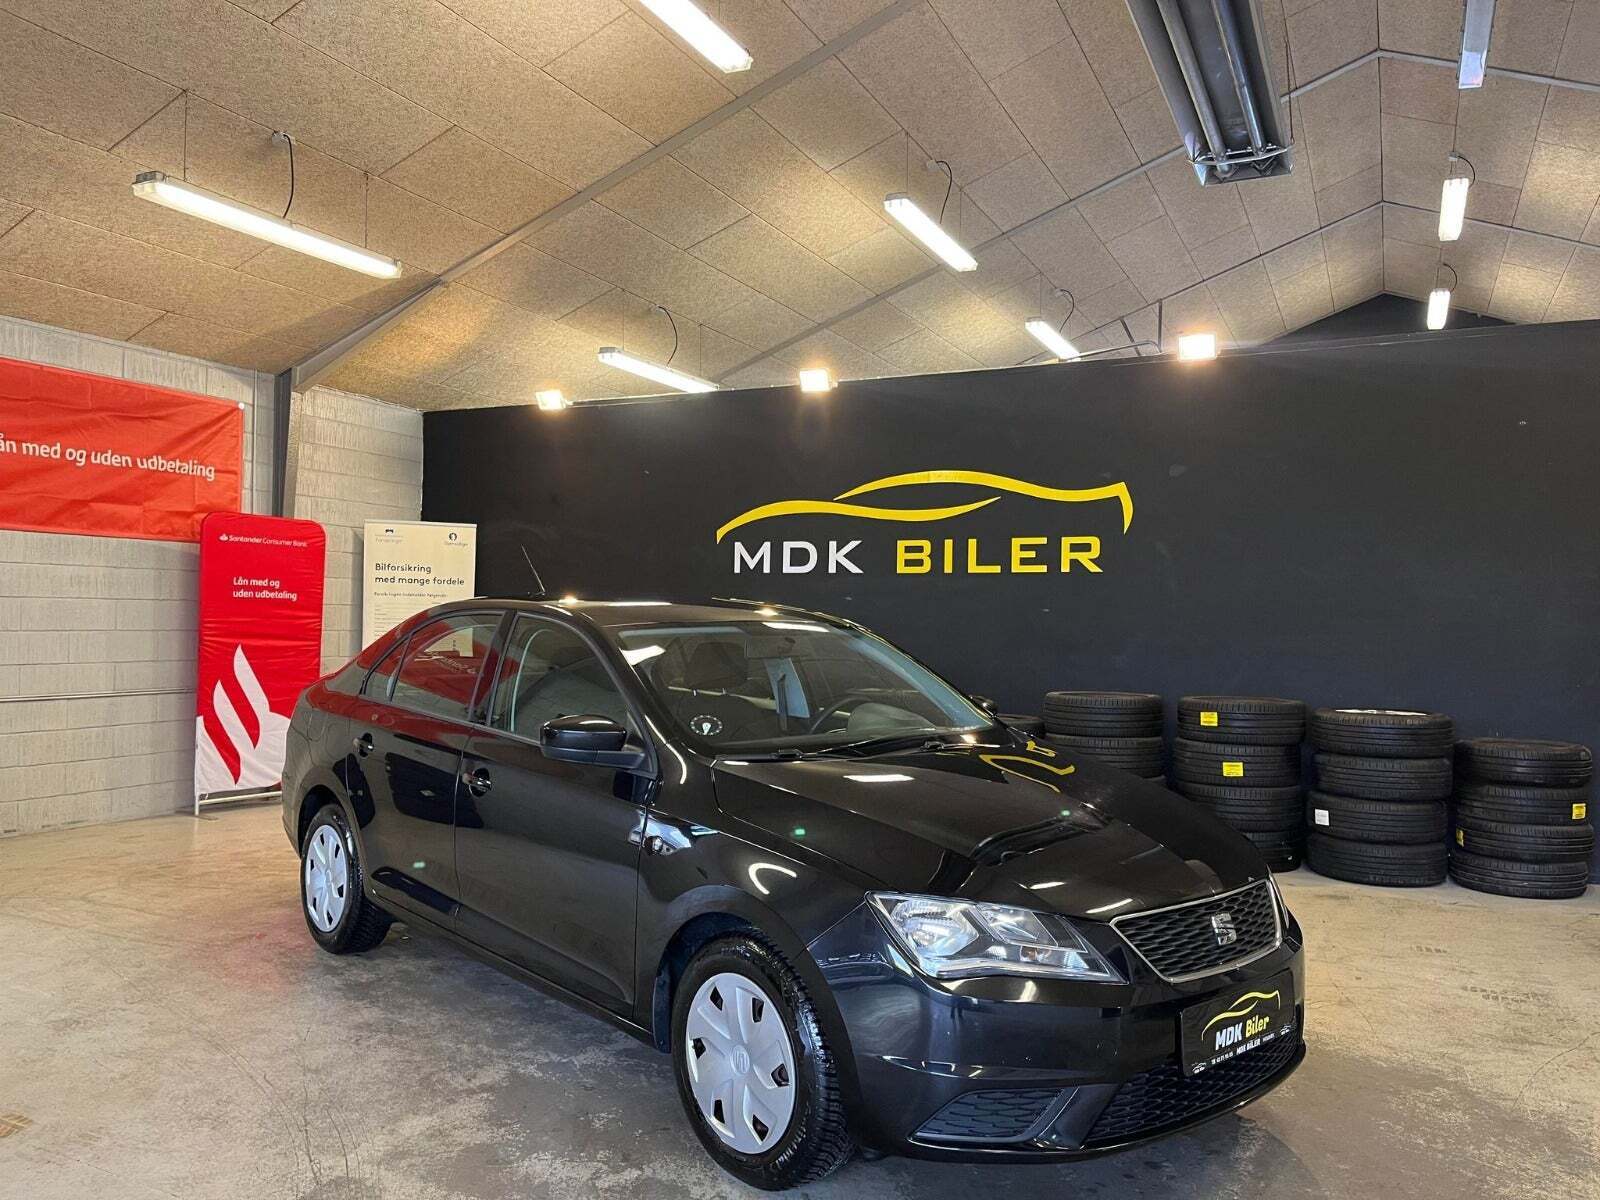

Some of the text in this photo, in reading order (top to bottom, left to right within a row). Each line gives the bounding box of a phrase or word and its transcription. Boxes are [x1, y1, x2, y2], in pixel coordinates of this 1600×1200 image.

[22, 442, 61, 459] med
[65, 448, 87, 466] og
[90, 449, 132, 468] uden
[136, 455, 215, 481] udbetaling
[228, 534, 262, 544] Santander
[262, 537, 292, 546] Consumer
[733, 535, 1103, 574] MDK BILER
[375, 562, 432, 575] Bilforsikring
[233, 576, 280, 589] Lån med og
[374, 576, 465, 587] med mange fordele
[233, 589, 297, 602] uden udbetaling
[1215, 1014, 1270, 1051] MDK Biler
